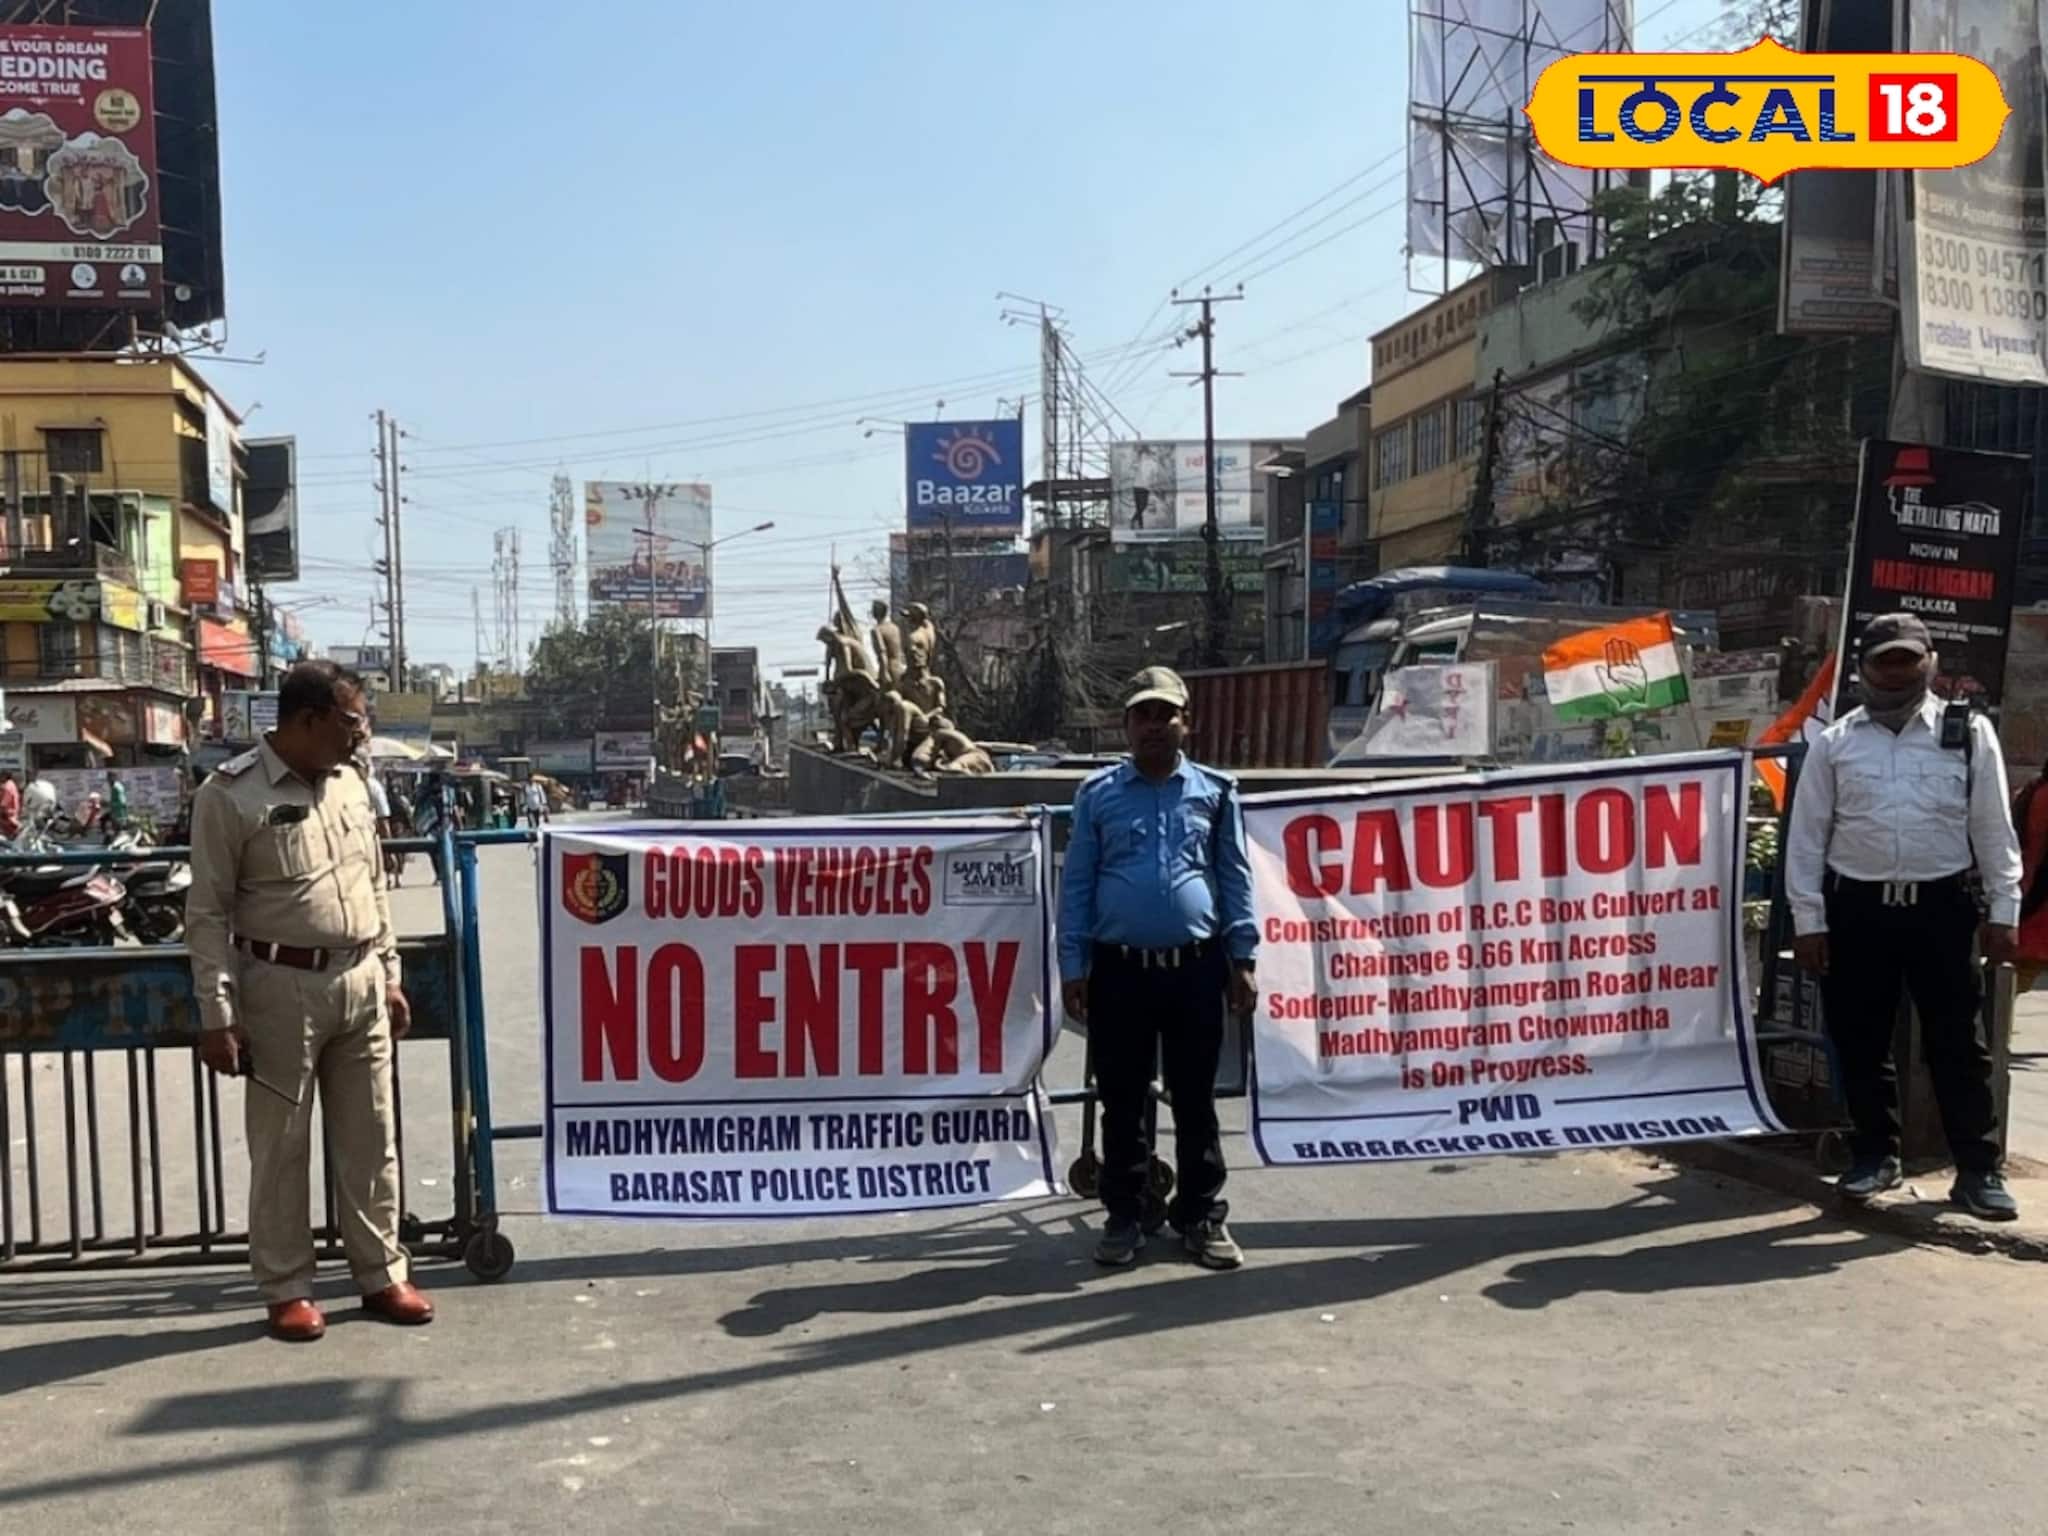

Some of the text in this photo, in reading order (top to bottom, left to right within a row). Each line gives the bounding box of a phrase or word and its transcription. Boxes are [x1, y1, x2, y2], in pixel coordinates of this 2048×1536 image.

[11, 40, 52, 53] YOUR
[55, 42, 108, 54] DREAM
[41, 82, 80, 95] TRUE
[917, 480, 1016, 504] Baazar
[1962, 511, 2000, 536] MAFIA
[1909, 543, 1959, 560] NOW IN
[1901, 596, 1957, 613] KOLKATA
[1282, 781, 1702, 899] CAUTION
[644, 846, 763, 919] GOODS
[773, 845, 934, 917] VEHICLES
[952, 861, 981, 875] SAFE
[1264, 885, 1721, 943] Construction of R.C.C Box Culvert at
[1330, 932, 1657, 981] Chainage 9.66 Km Across
[580, 941, 1021, 1083] NO ENTRY
[1268, 963, 1719, 1020] Sodepur-Madhyamgram Road Near
[1319, 1006, 1670, 1059] Madhyamgram Chowmatha
[1401, 1052, 1593, 1090] is On Progress.
[1458, 1094, 1542, 1125] PWD
[566, 1109, 1031, 1158] MADHYAMGRAM TRAFFIC GUARD
[1292, 1115, 1732, 1160] BARRACKPORE DIVISION
[610, 1159, 991, 1203] BARASAT POLICE DISTRICT
